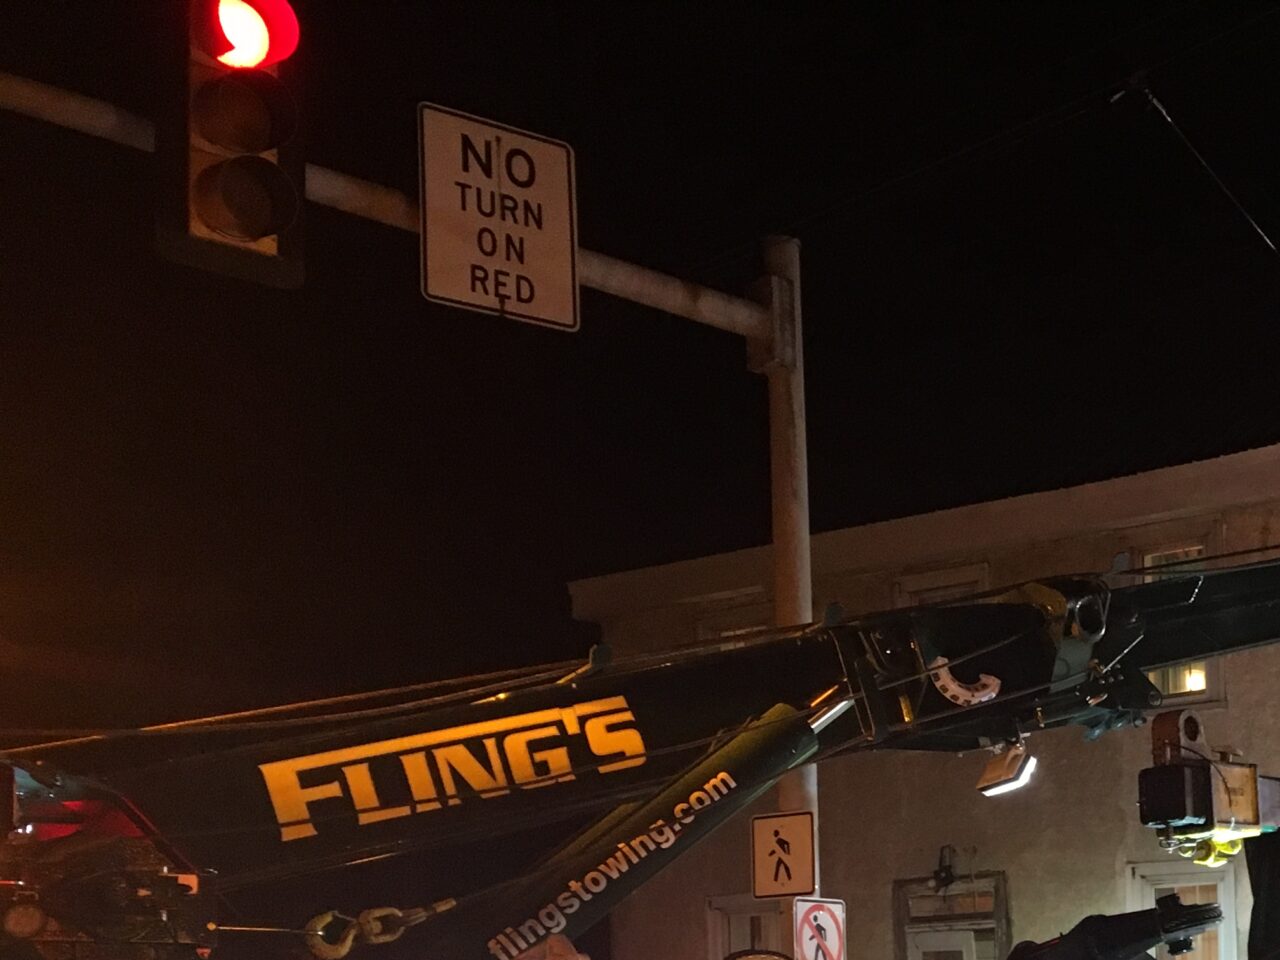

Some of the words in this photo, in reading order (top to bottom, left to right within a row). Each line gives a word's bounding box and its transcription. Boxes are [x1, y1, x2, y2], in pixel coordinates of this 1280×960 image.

[461, 133, 536, 188] NO
[454, 181, 543, 230] TURN
[477, 227, 524, 265] ON
[470, 263, 535, 304] RED
[258, 695, 647, 841] FLING'S
